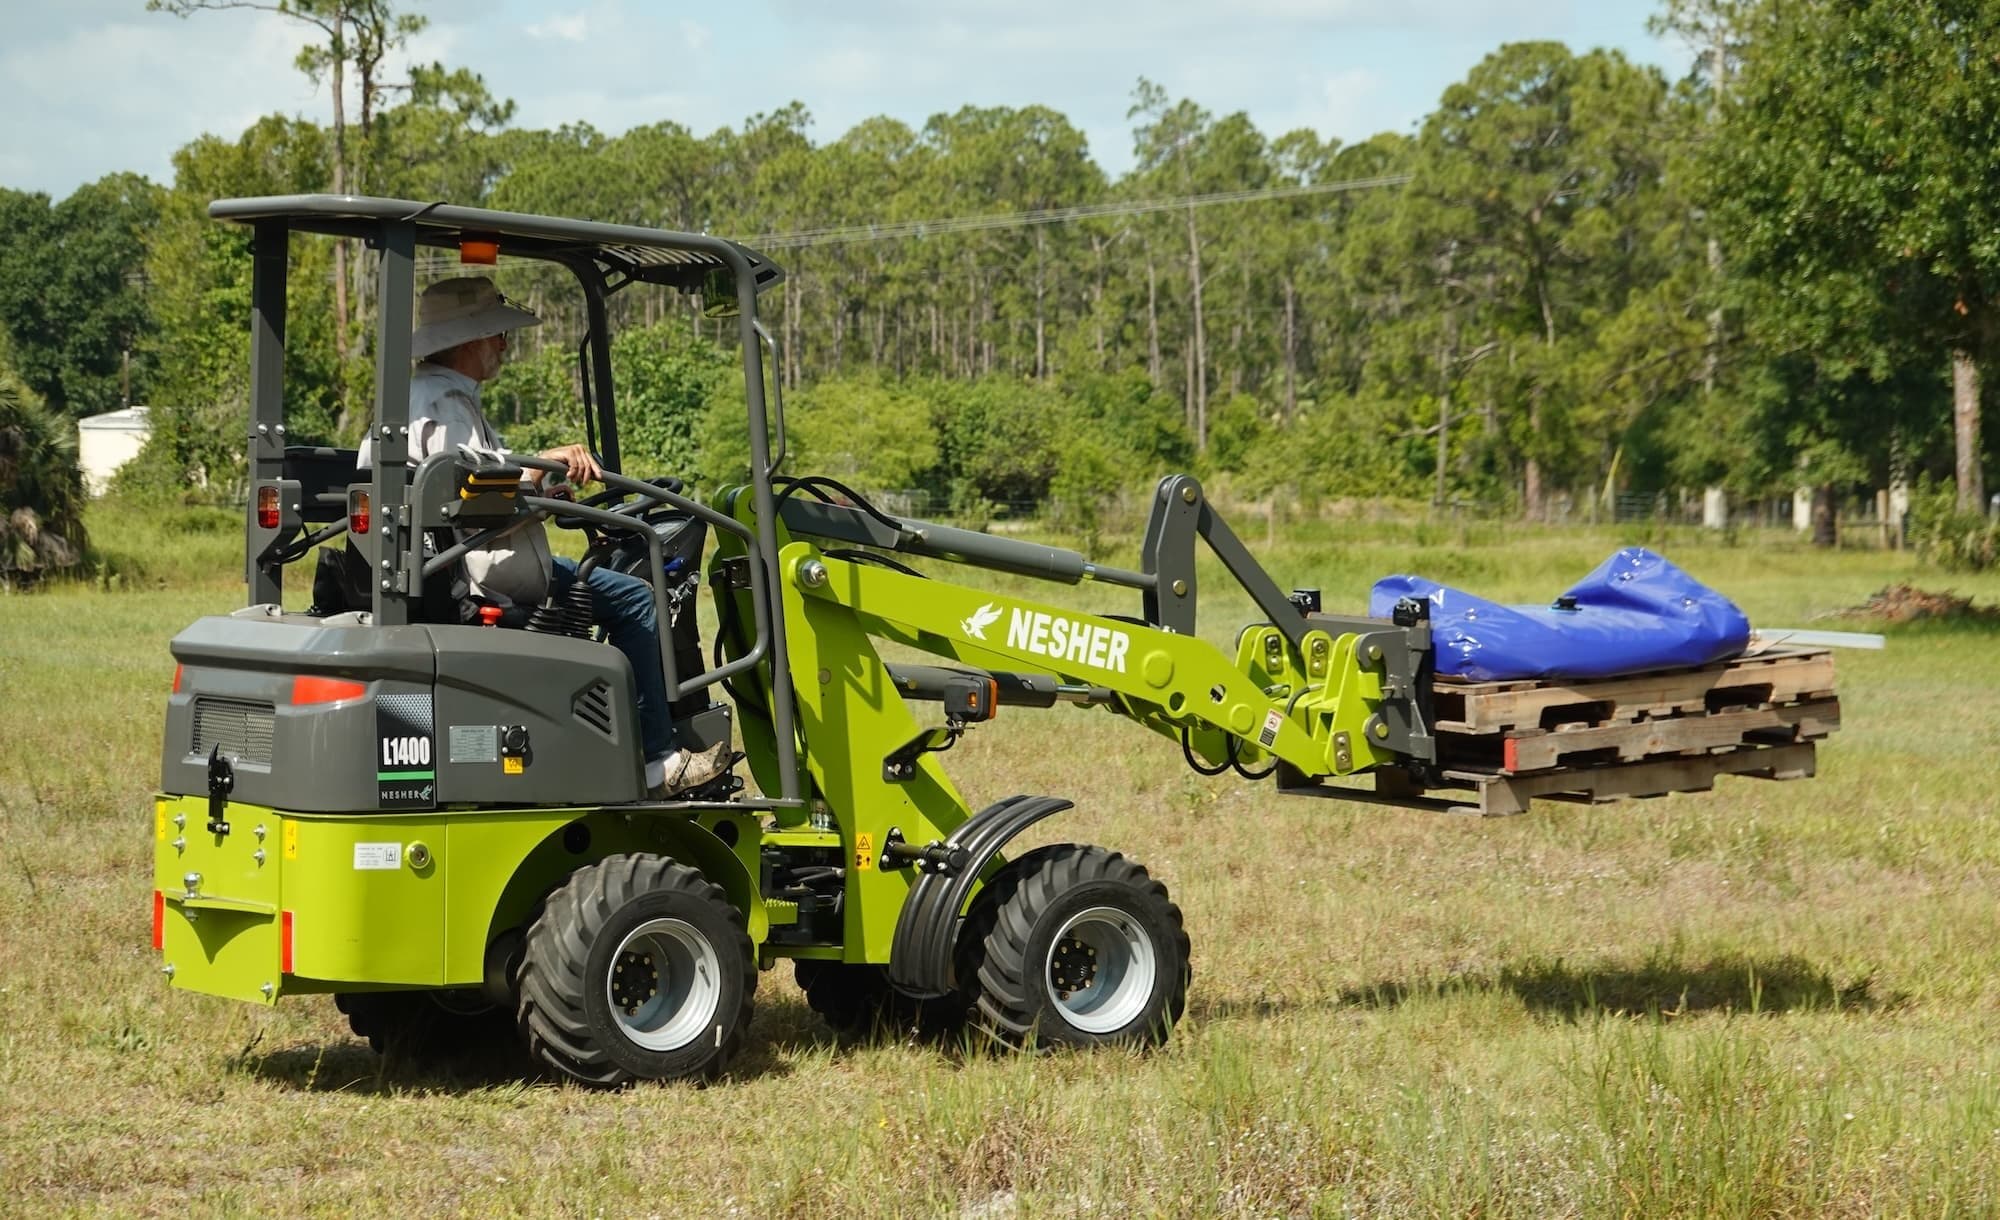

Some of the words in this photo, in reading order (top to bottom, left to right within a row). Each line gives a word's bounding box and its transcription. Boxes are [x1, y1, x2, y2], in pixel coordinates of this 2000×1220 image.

[1007, 608, 1130, 673] NESHER
[383, 736, 430, 765] L1400
[381, 791, 420, 800] NESHER
